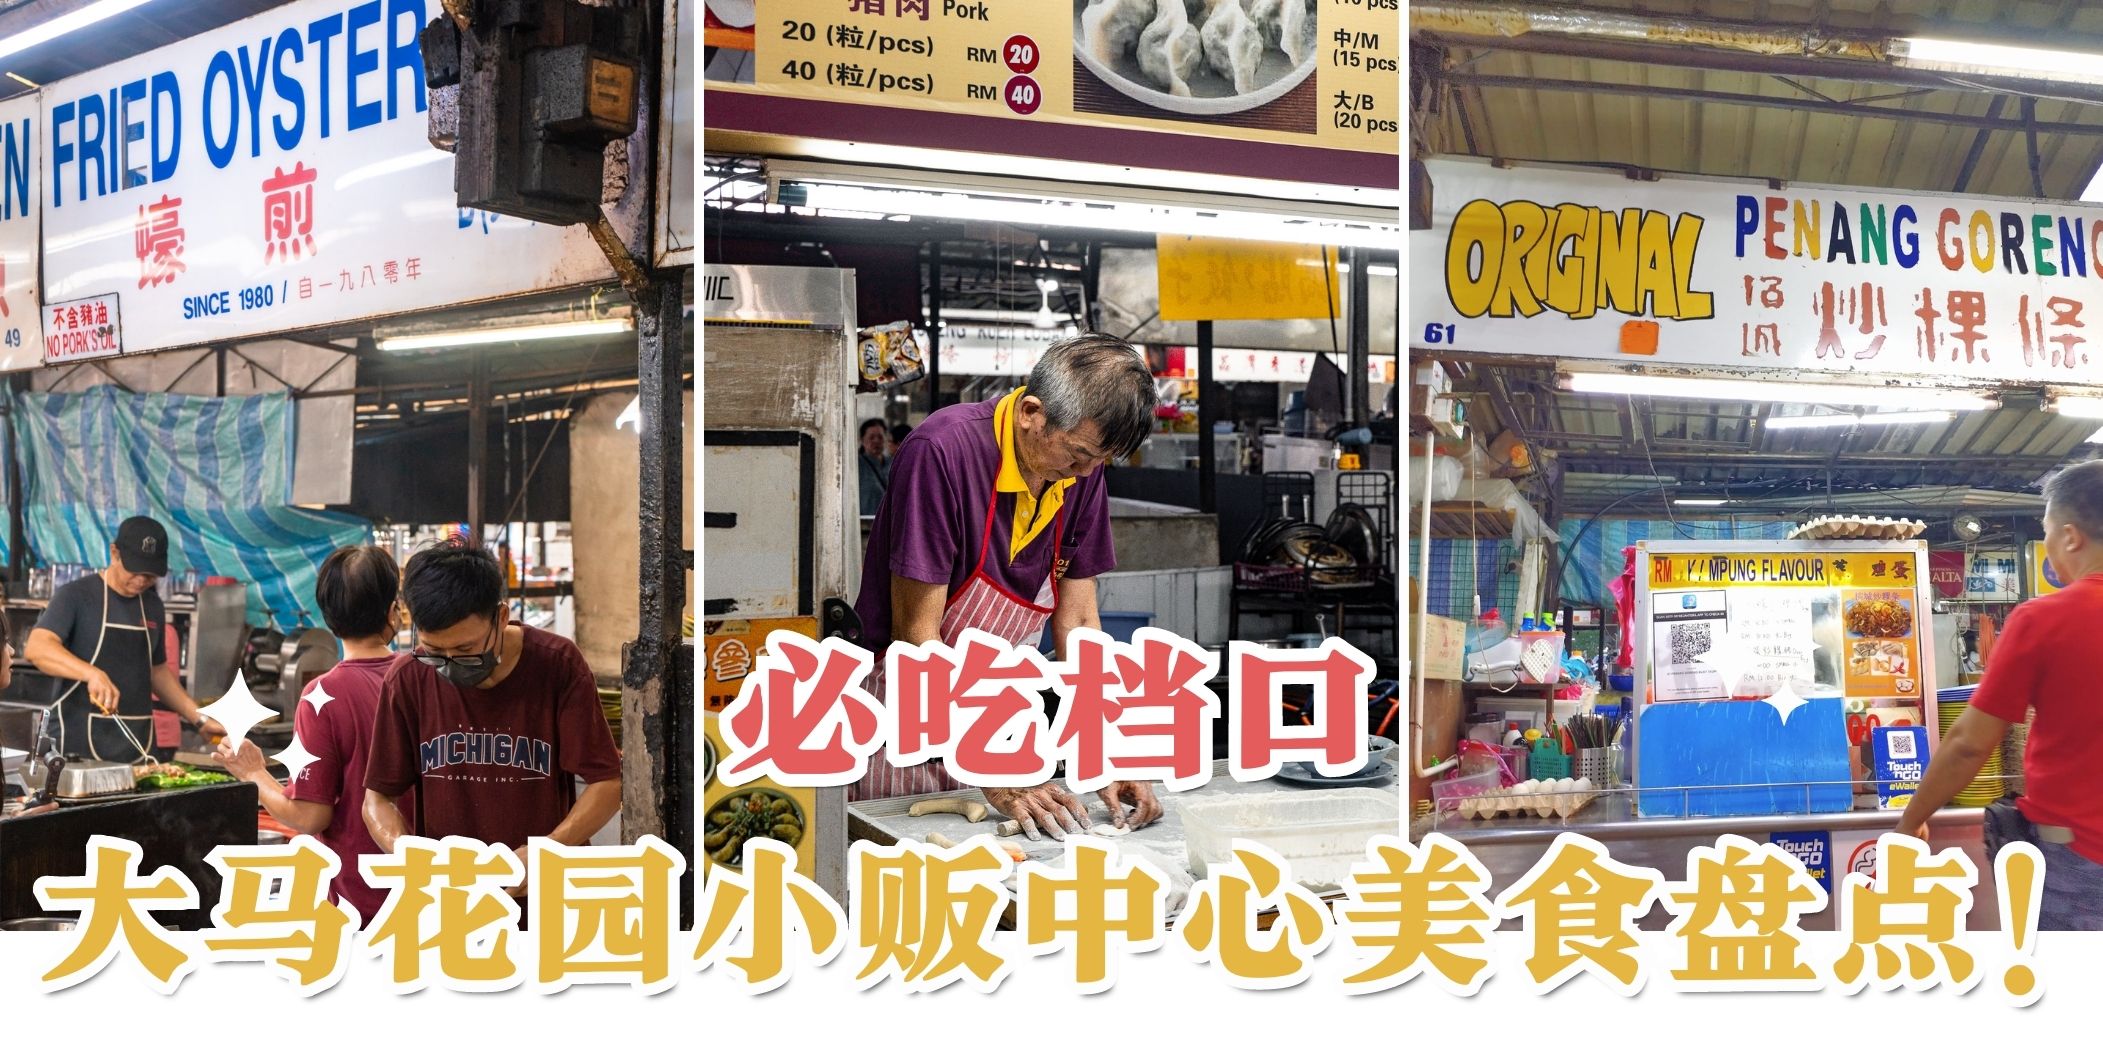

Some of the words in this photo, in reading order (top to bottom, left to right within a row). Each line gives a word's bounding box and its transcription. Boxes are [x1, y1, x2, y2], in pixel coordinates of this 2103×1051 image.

[943, 0, 989, 22] Pork
[782, 20, 816, 42] 20
[826, 24, 934, 57] (粒/pcs)
[967, 46, 997, 64] RM
[1009, 44, 1033, 65] 20
[1333, 28, 1379, 50] 中/M
[1333, 48, 1361, 67] (15
[782, 60, 816, 81] 40
[826, 63, 934, 95] (粒/pcs)
[967, 83, 997, 101] RM
[1011, 85, 1035, 105] 40
[1333, 90, 1375, 111] 大/B
[1334, 110, 1361, 129] (20
[52, 70, 181, 208] FRIED
[0, 118, 30, 220] N
[1735, 195, 1920, 269] PENANG
[1444, 199, 1715, 321] ORIGINAL
[183, 291, 230, 320] SINCE
[238, 285, 274, 311] 1980
[299, 257, 422, 300] 自一九八零年
[5, 327, 21, 347] 49
[46, 334, 61, 358] NO
[62, 328, 98, 355] PORK'S
[1424, 322, 1456, 344] 61
[1761, 557, 1825, 582] FLAVOUR
[1930, 571, 1963, 583] ALTA
[420, 732, 551, 777] MICHIGAN
[1887, 761, 1922, 771] Touch
[447, 774, 488, 783] GARAGE
